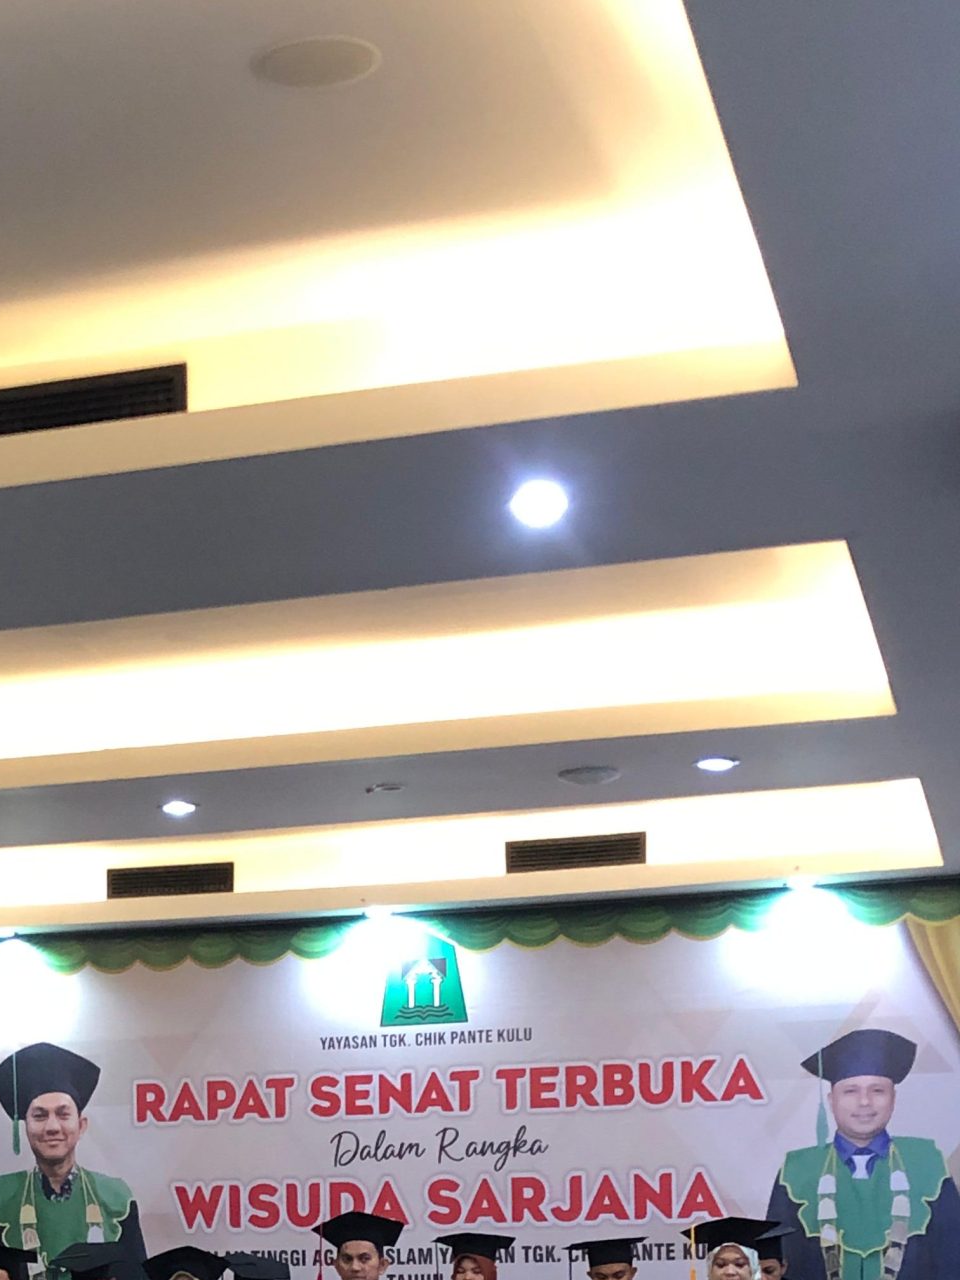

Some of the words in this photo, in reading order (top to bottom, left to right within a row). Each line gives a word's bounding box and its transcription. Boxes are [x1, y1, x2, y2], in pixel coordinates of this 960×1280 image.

[319, 1034, 377, 1050] YAYASAN
[381, 1032, 411, 1048] TGK.
[415, 1030, 447, 1046] CHIK
[450, 1028, 493, 1045] PANTE
[497, 1027, 533, 1042] KULU
[136, 1077, 295, 1123] RAPAT
[310, 1069, 480, 1117] SENAT
[496, 1058, 765, 1110] TERBUKA
[330, 1130, 426, 1169] Dalam
[437, 1125, 550, 1172] Rangka
[174, 1180, 410, 1230] WISUDA
[428, 1172, 725, 1224] SARJANA
[385, 1247, 433, 1266] SLAM
[522, 1244, 562, 1263] TGK.
[632, 1243, 676, 1261] ANTE
